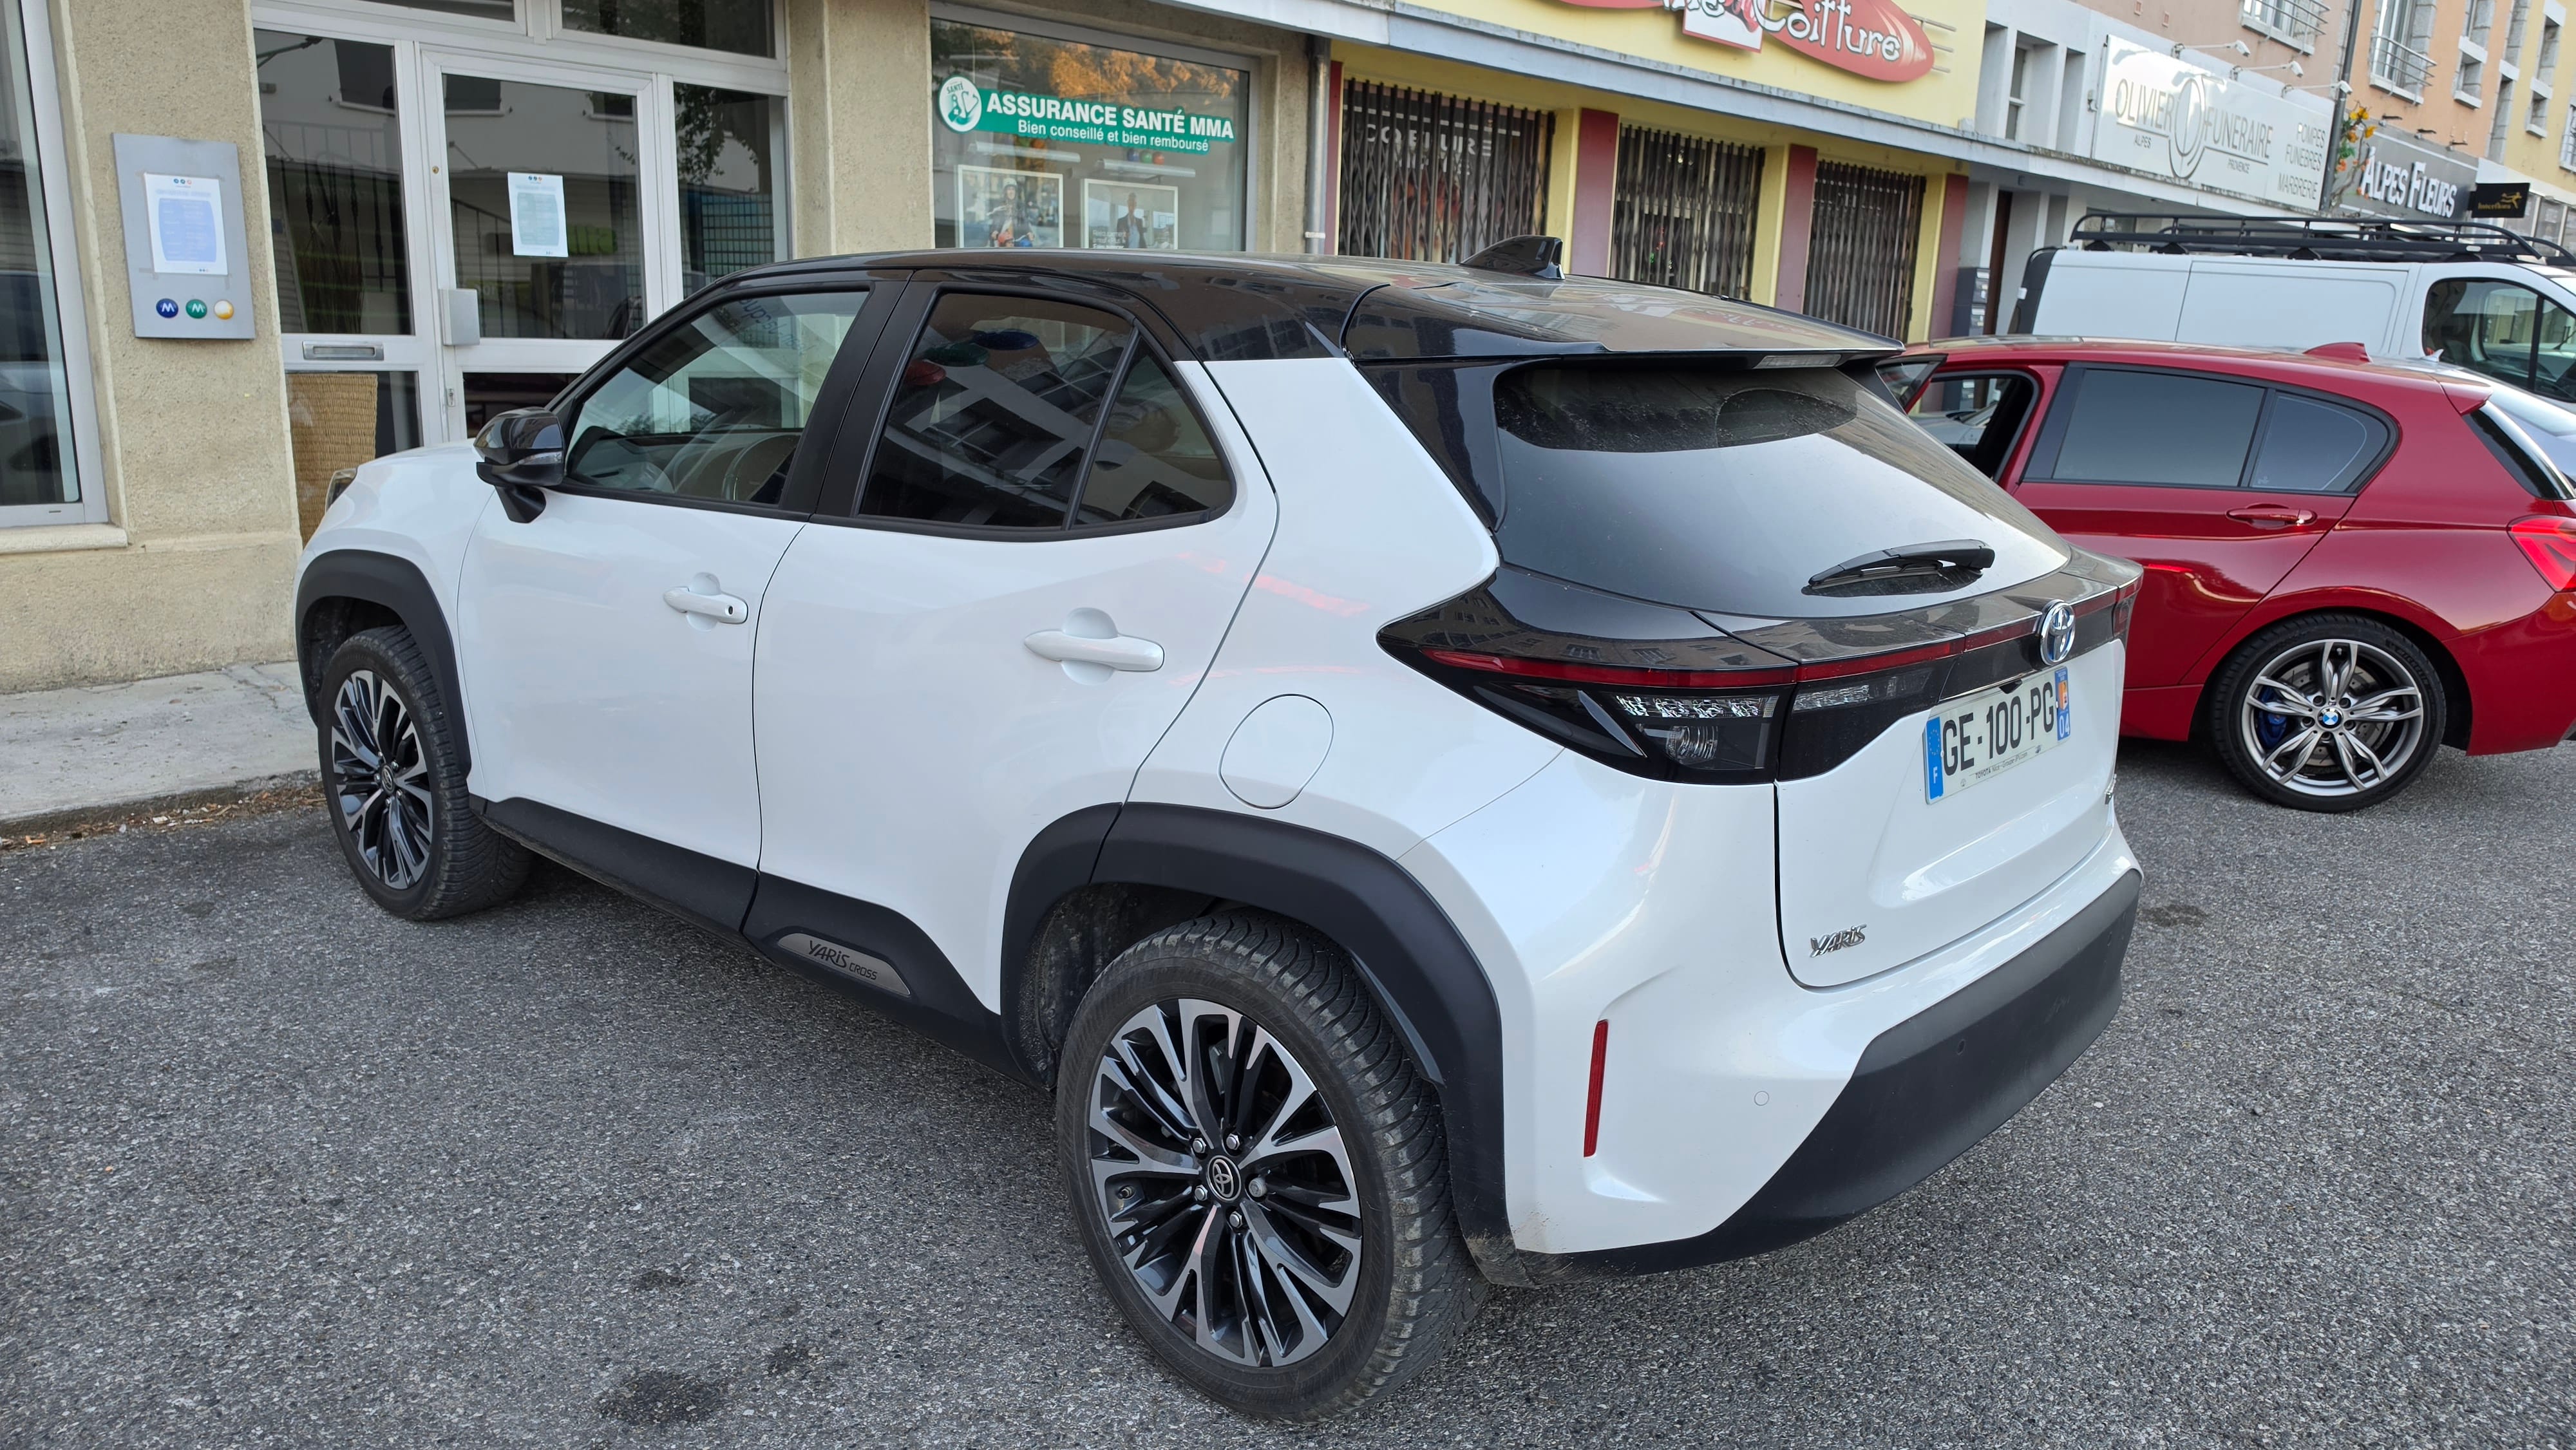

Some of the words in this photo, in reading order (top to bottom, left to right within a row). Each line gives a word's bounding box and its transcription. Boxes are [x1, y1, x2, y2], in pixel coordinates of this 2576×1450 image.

[986, 93, 1117, 126] ASSURANCE
[1122, 109, 1186, 134] SANTÉ
[1190, 117, 1235, 139] MMA
[2116, 78, 2175, 133] OLIVIER
[2203, 106, 2273, 160] FUNERAIRE
[1018, 118, 1047, 135] Bien
[1050, 124, 1104, 141] conseillé
[1107, 131, 1119, 142] et
[1122, 130, 1147, 145] bien
[1150, 136, 1209, 152] remboursé
[2361, 146, 2409, 205] ALPES
[2407, 162, 2458, 218] FLEURS
[1942, 681, 2054, 777] GE-100-PG
[2059, 713, 2070, 738] 04
[1933, 766, 1938, 784] F
[1975, 767, 1992, 779] TOYOTA
[849, 962, 878, 981] CROSS
